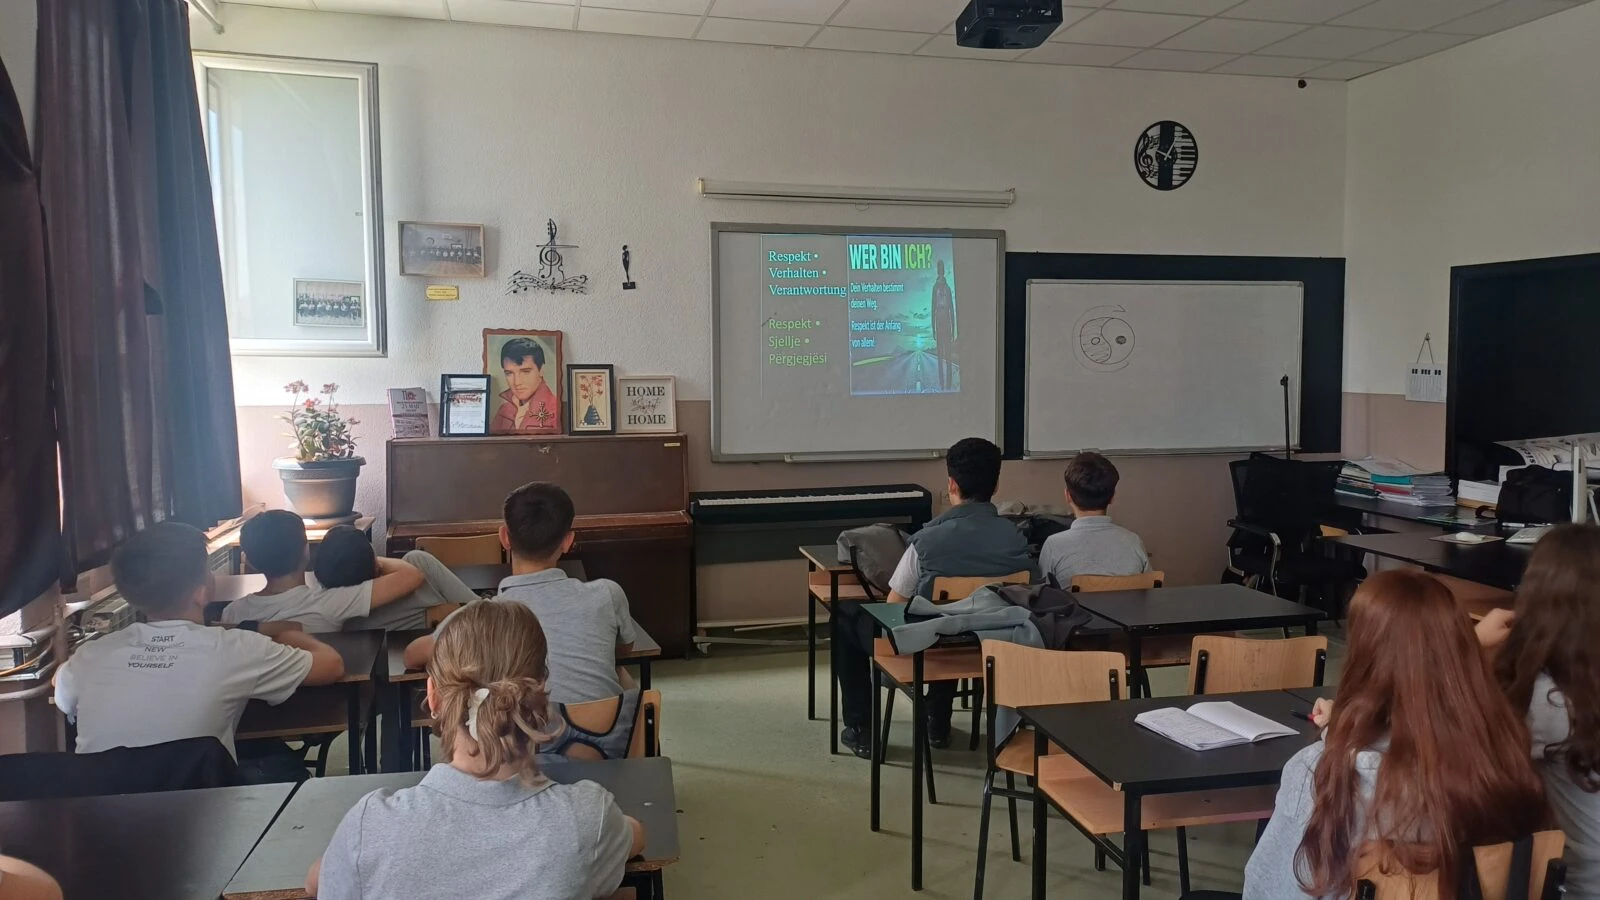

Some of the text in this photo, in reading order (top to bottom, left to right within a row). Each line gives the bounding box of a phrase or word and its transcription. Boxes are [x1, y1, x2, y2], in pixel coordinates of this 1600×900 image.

[768, 250, 811, 263] Respekt
[850, 243, 932, 270] WER BIN ICH?
[769, 267, 819, 278] Verhalten
[769, 284, 847, 297] Verantwortung
[850, 282, 904, 292] Dein Verhalten bestimmt
[768, 318, 812, 331] Respekt
[851, 320, 869, 332] Respekt
[885, 320, 901, 332] Anfang
[768, 335, 801, 349] Sjellje
[769, 352, 827, 366] Përgjegjësi
[626, 386, 665, 396] HOME
[627, 414, 666, 425] HOME
